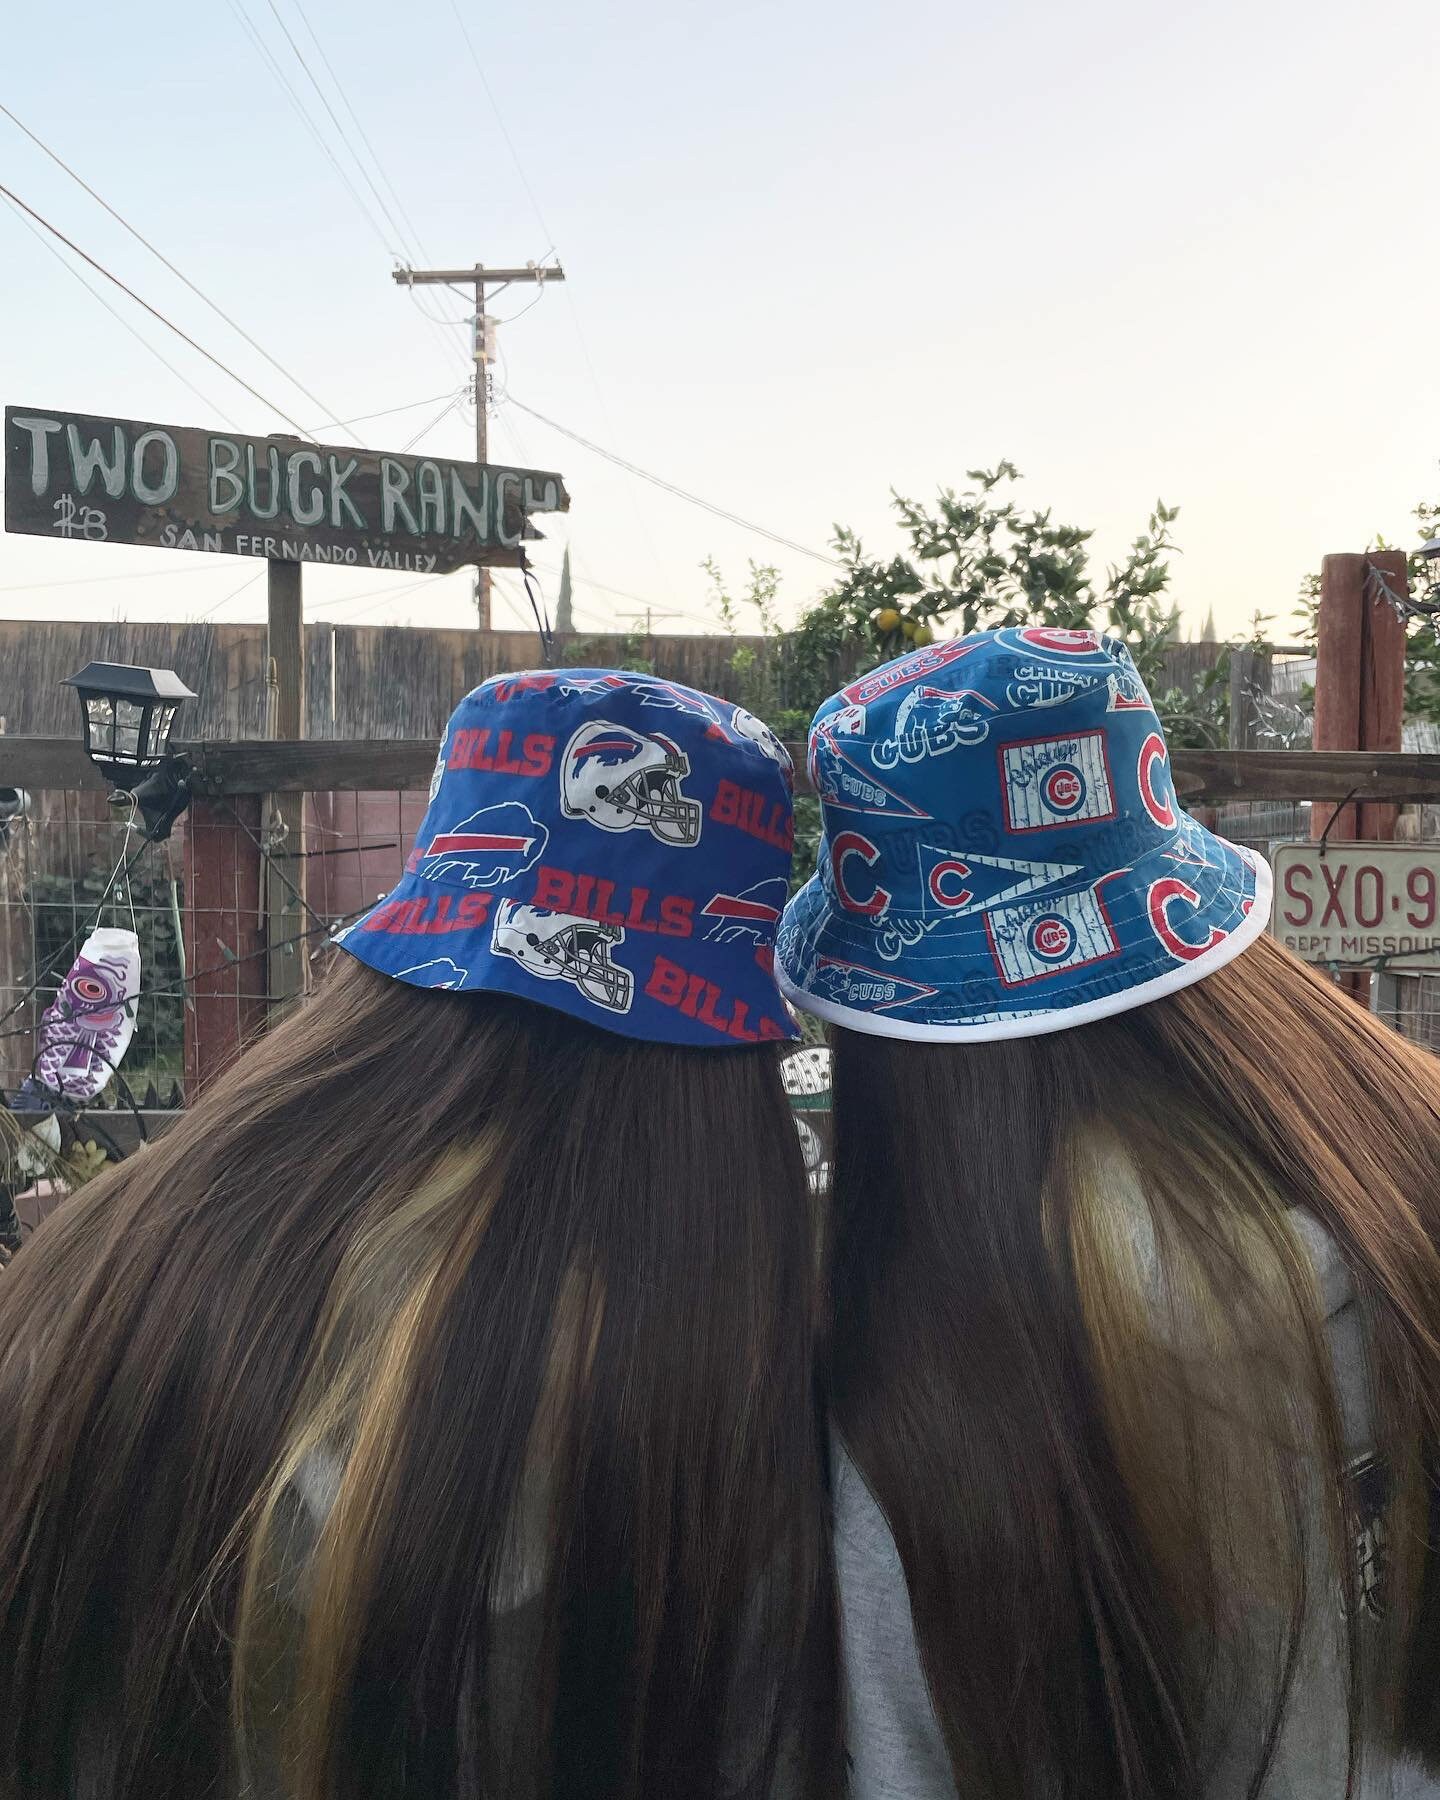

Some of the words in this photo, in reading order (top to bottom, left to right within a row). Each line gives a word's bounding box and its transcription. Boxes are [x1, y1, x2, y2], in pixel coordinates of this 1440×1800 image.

[12, 417, 180, 505] TWO
[209, 439, 368, 528] BUCK
[160, 523, 222, 553] SAN
[236, 534, 358, 562] FERNANDO
[367, 548, 438, 573] VALLEY
[448, 727, 557, 777] BILLS
[871, 711, 990, 770] CUBS
[841, 773, 887, 807] CUBS
[531, 866, 695, 938] BILLS
[928, 860, 974, 909] C
[362, 892, 495, 935] BILLS
[1284, 935, 1331, 952] SEPT
[847, 982, 896, 1001] CUBS
